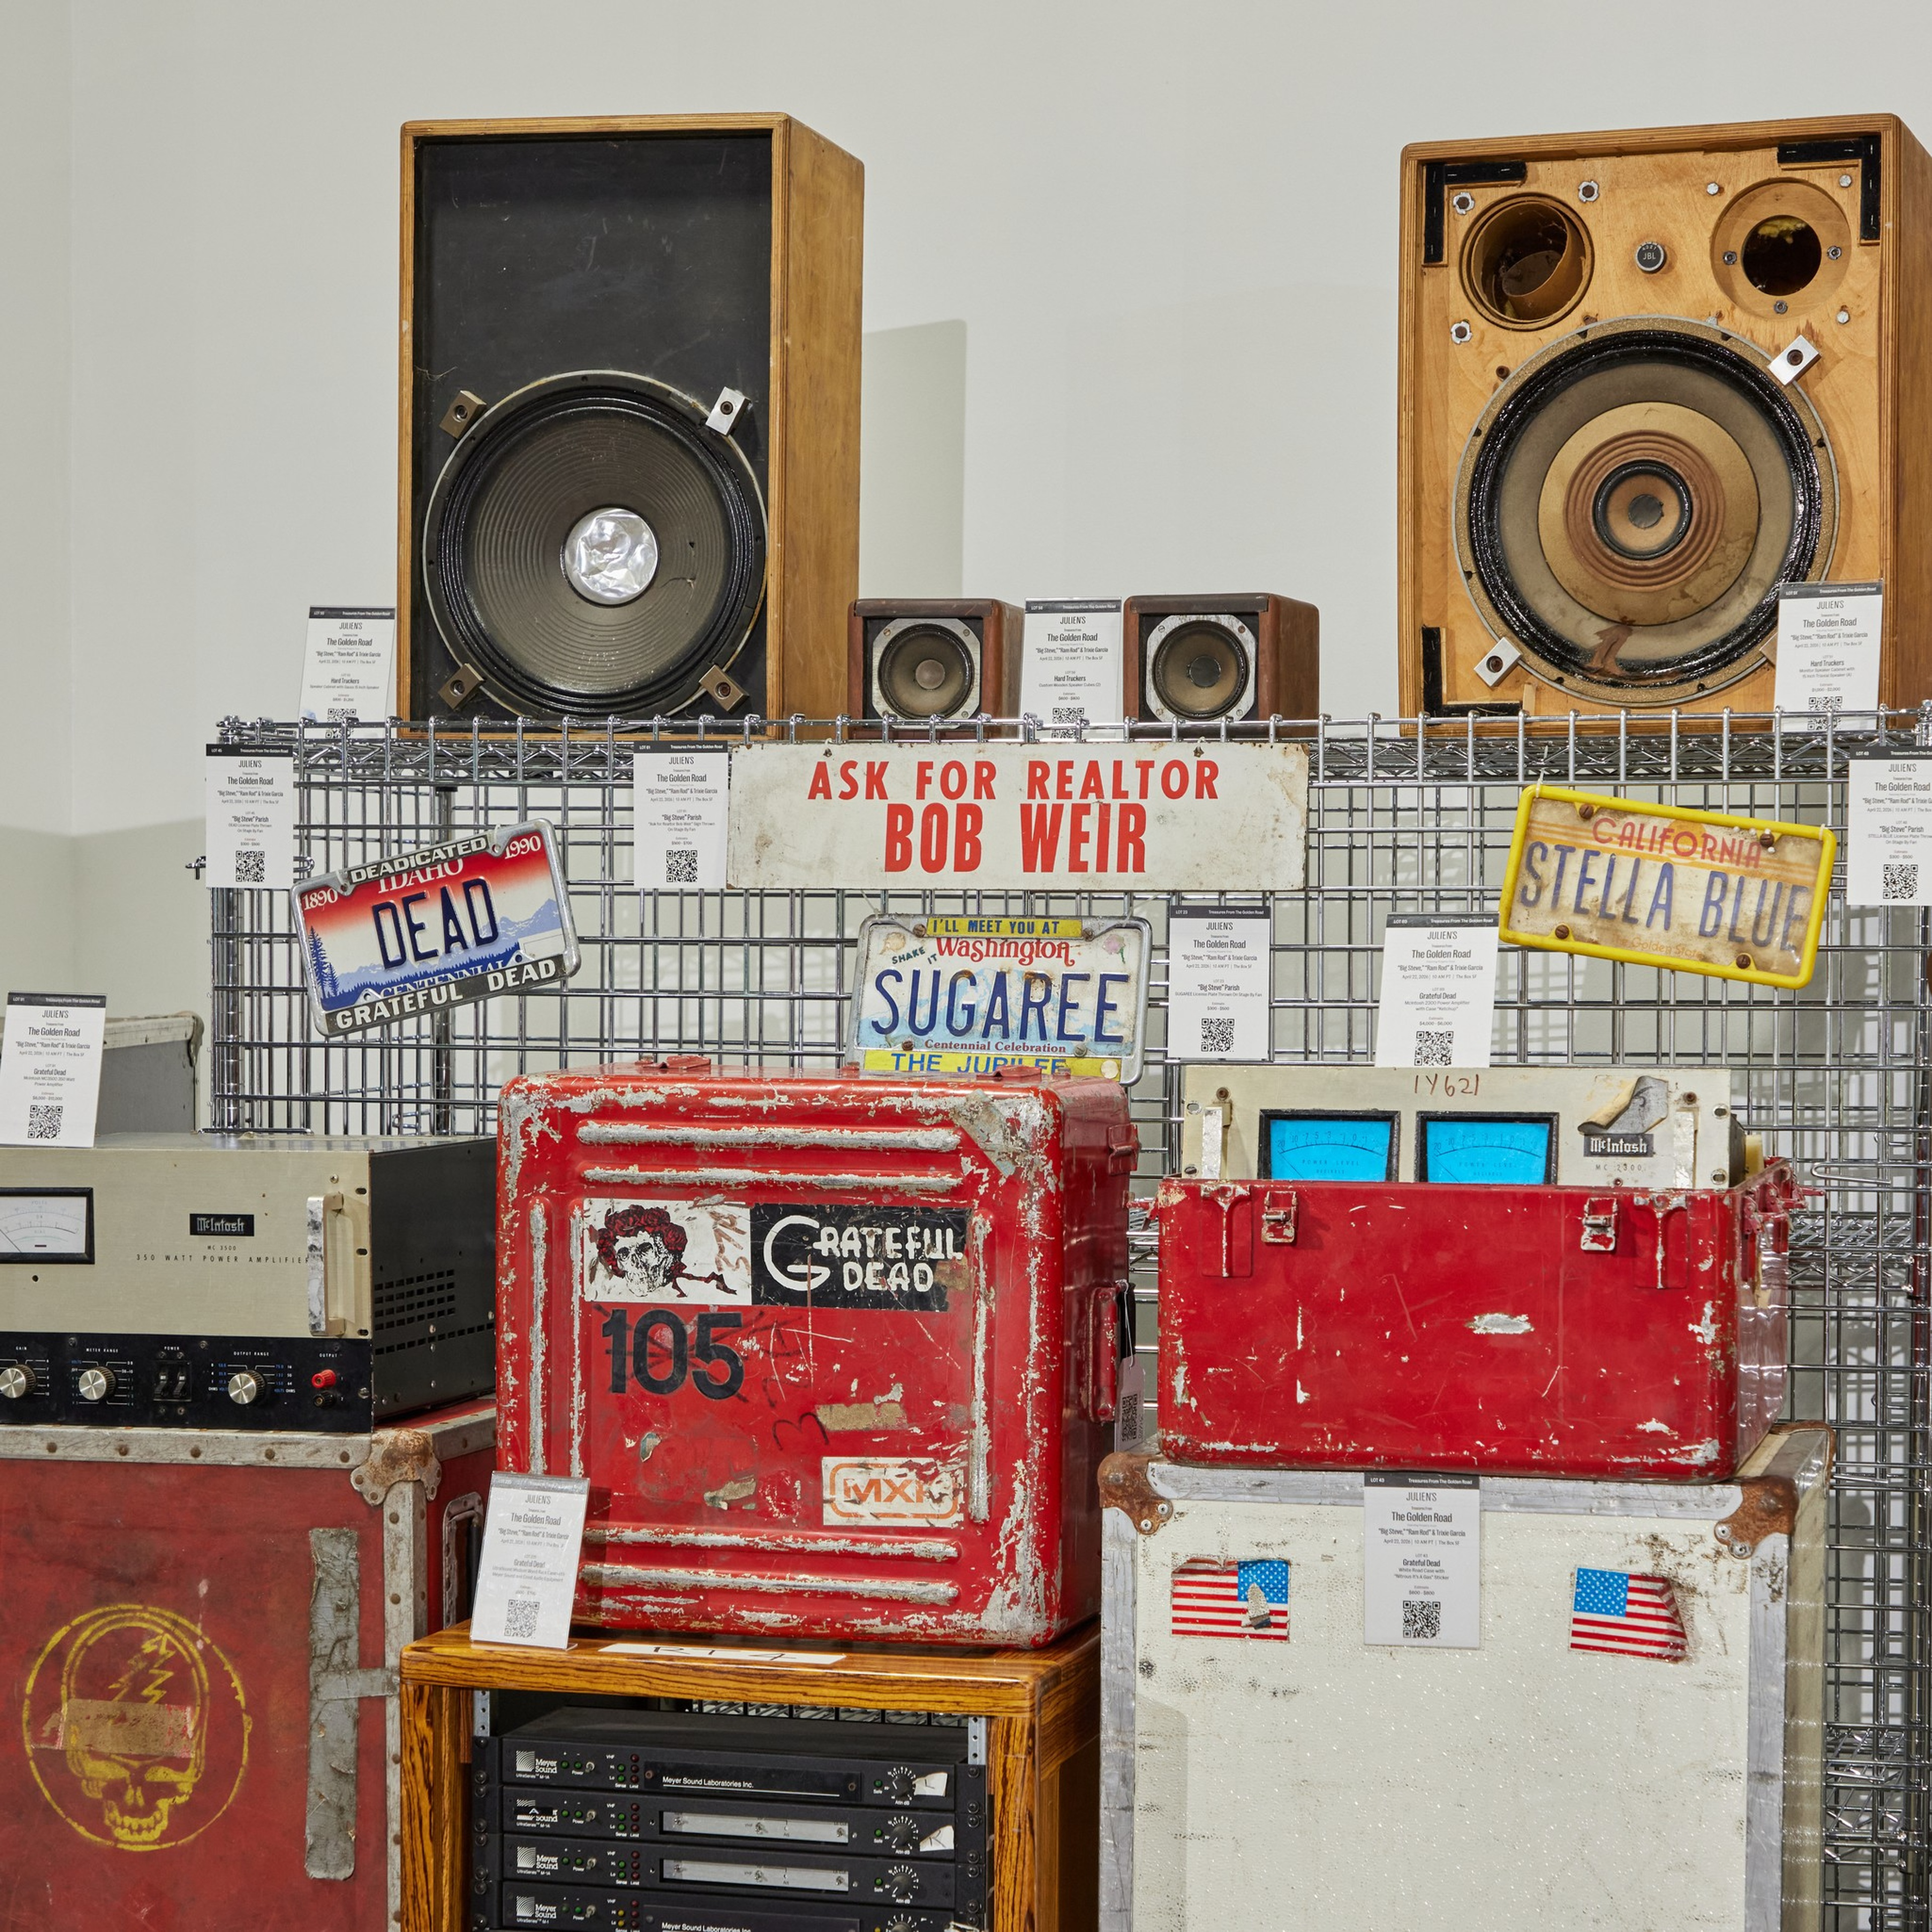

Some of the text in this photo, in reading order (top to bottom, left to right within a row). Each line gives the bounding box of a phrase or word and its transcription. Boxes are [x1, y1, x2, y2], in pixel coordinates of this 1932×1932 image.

[1643, 252, 1656, 260] JBL
[1817, 600, 1844, 609] JULIEN'S
[1060, 616, 1086, 624] JULIEN'S
[1803, 618, 1857, 628] The Golden Road
[338, 638, 357, 646] Golden
[1048, 633, 1098, 641] The Golden Road
[669, 756, 694, 765] JULIEN'S
[1888, 763, 1916, 772] JULIEN'S
[228, 776, 273, 785] The Golden Road
[657, 774, 706, 782] The Golden Road
[807, 759, 1219, 800] ASK FOR REALTOR
[1875, 782, 1930, 791] The Golden Road
[884, 802, 1146, 873] BOB WEIR
[1592, 817, 1762, 868] CALIFORNIA
[504, 835, 541, 860] 1990
[378, 857, 464, 894] IDAHO
[301, 887, 338, 911] 1890
[1519, 841, 1809, 952] STELLA BLUE
[372, 875, 499, 970] DEAD
[933, 919, 1060, 934] I'LL MEET YOU AT
[1206, 922, 1233, 930] JULIEN'S
[1427, 931, 1457, 940] JULIEN'S
[1193, 939, 1246, 948] The Golden Road
[892, 946, 926, 964] SHAKE
[936, 938, 1075, 967] Washington
[1412, 949, 1471, 958] The Golden Road
[927, 953, 937, 964] IT
[335, 959, 555, 1029] GRATEFUL DEAD
[871, 968, 1129, 1043] SUGAREE
[42, 1010, 68, 1018] JULIEN'S
[29, 1027, 80, 1036] The Golden Road
[925, 1039, 1066, 1053] Centennial Celebration
[891, 1053, 942, 1071] THE
[1590, 1137, 1647, 1154] McIntosh
[1617, 1164, 1642, 1172] 2300
[196, 1217, 245, 1233] McIntosh
[763, 1215, 963, 1292] GRATEFUL
[843, 1262, 934, 1292] DEAD
[601, 1308, 745, 1401] 105
[525, 1494, 551, 1505] JULIEN'S
[1406, 1492, 1437, 1501] JULIEN'S
[511, 1512, 561, 1525] The Golden Road
[1392, 1511, 1452, 1522] The Golden Road
[663, 1776, 754, 1789] Meyer Sound Laboratories Inc.
[536, 1854, 558, 1863] Meyer
[535, 1904, 557, 1912] Meyer
[682, 1923, 702, 1931] Sound
